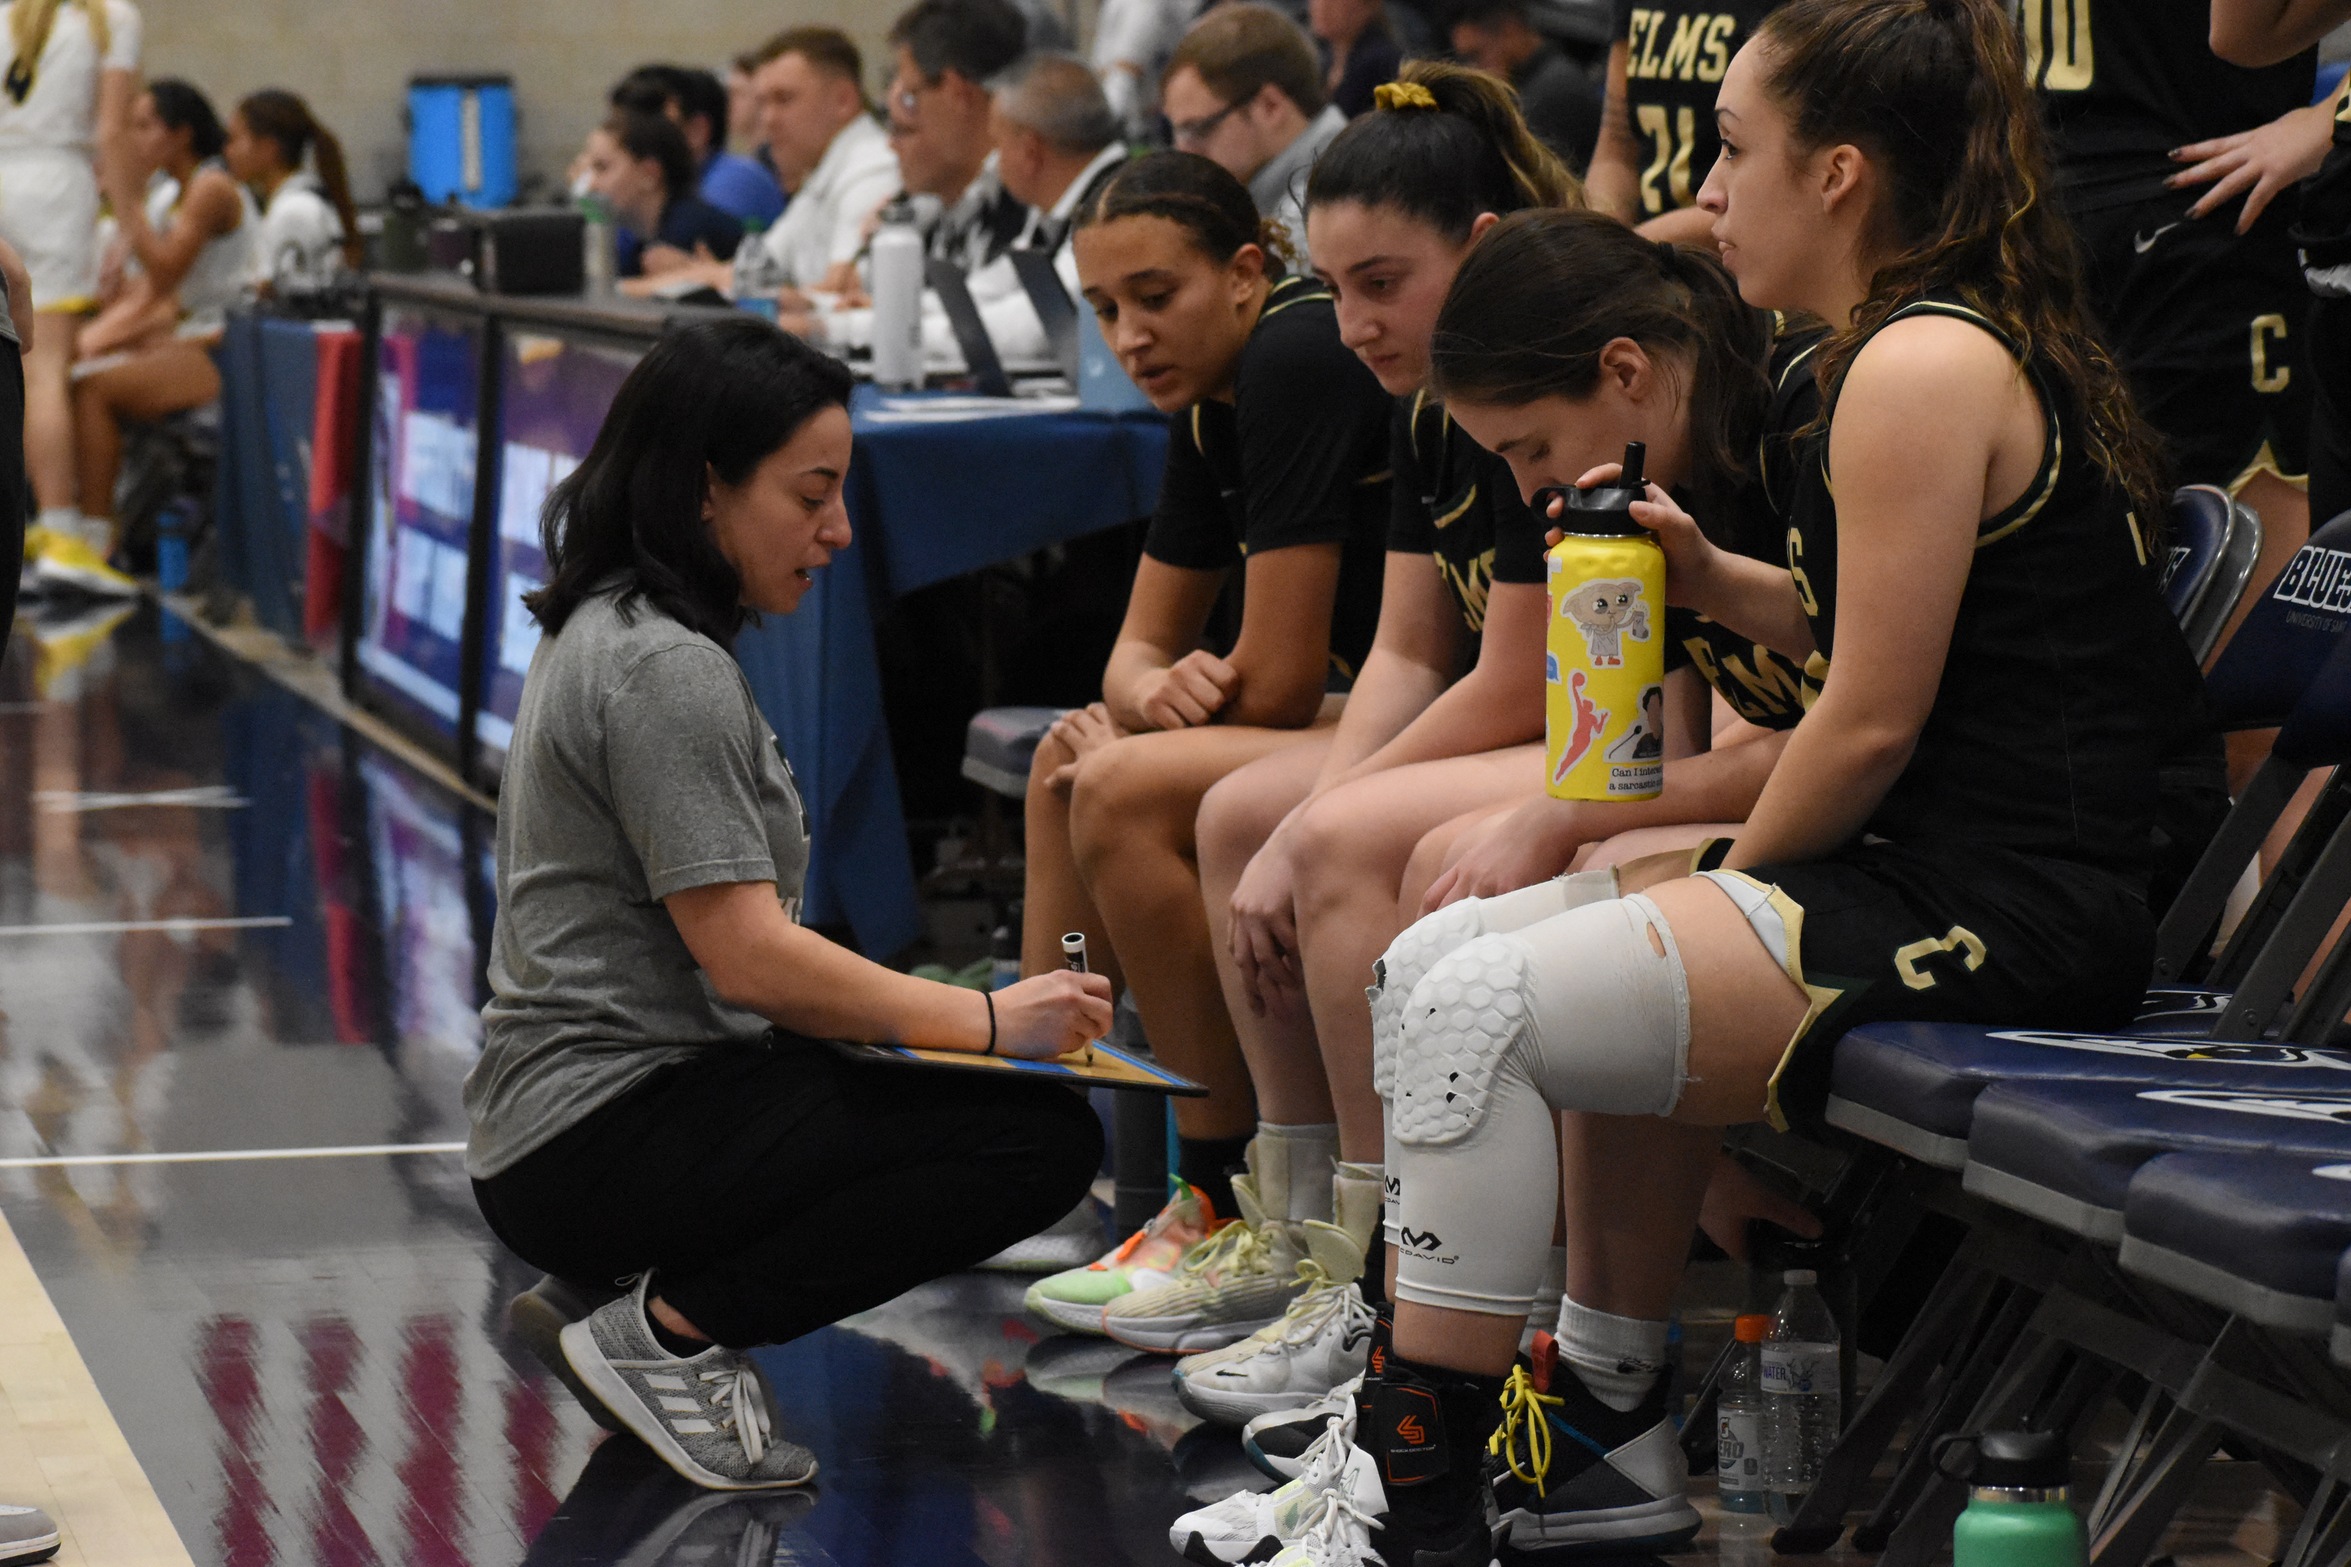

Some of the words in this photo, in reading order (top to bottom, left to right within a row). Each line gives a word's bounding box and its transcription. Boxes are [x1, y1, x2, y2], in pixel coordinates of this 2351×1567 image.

[1626, 8, 1736, 82] ELMS
[2252, 314, 2290, 392] C
[1612, 768, 1632, 777] Can
